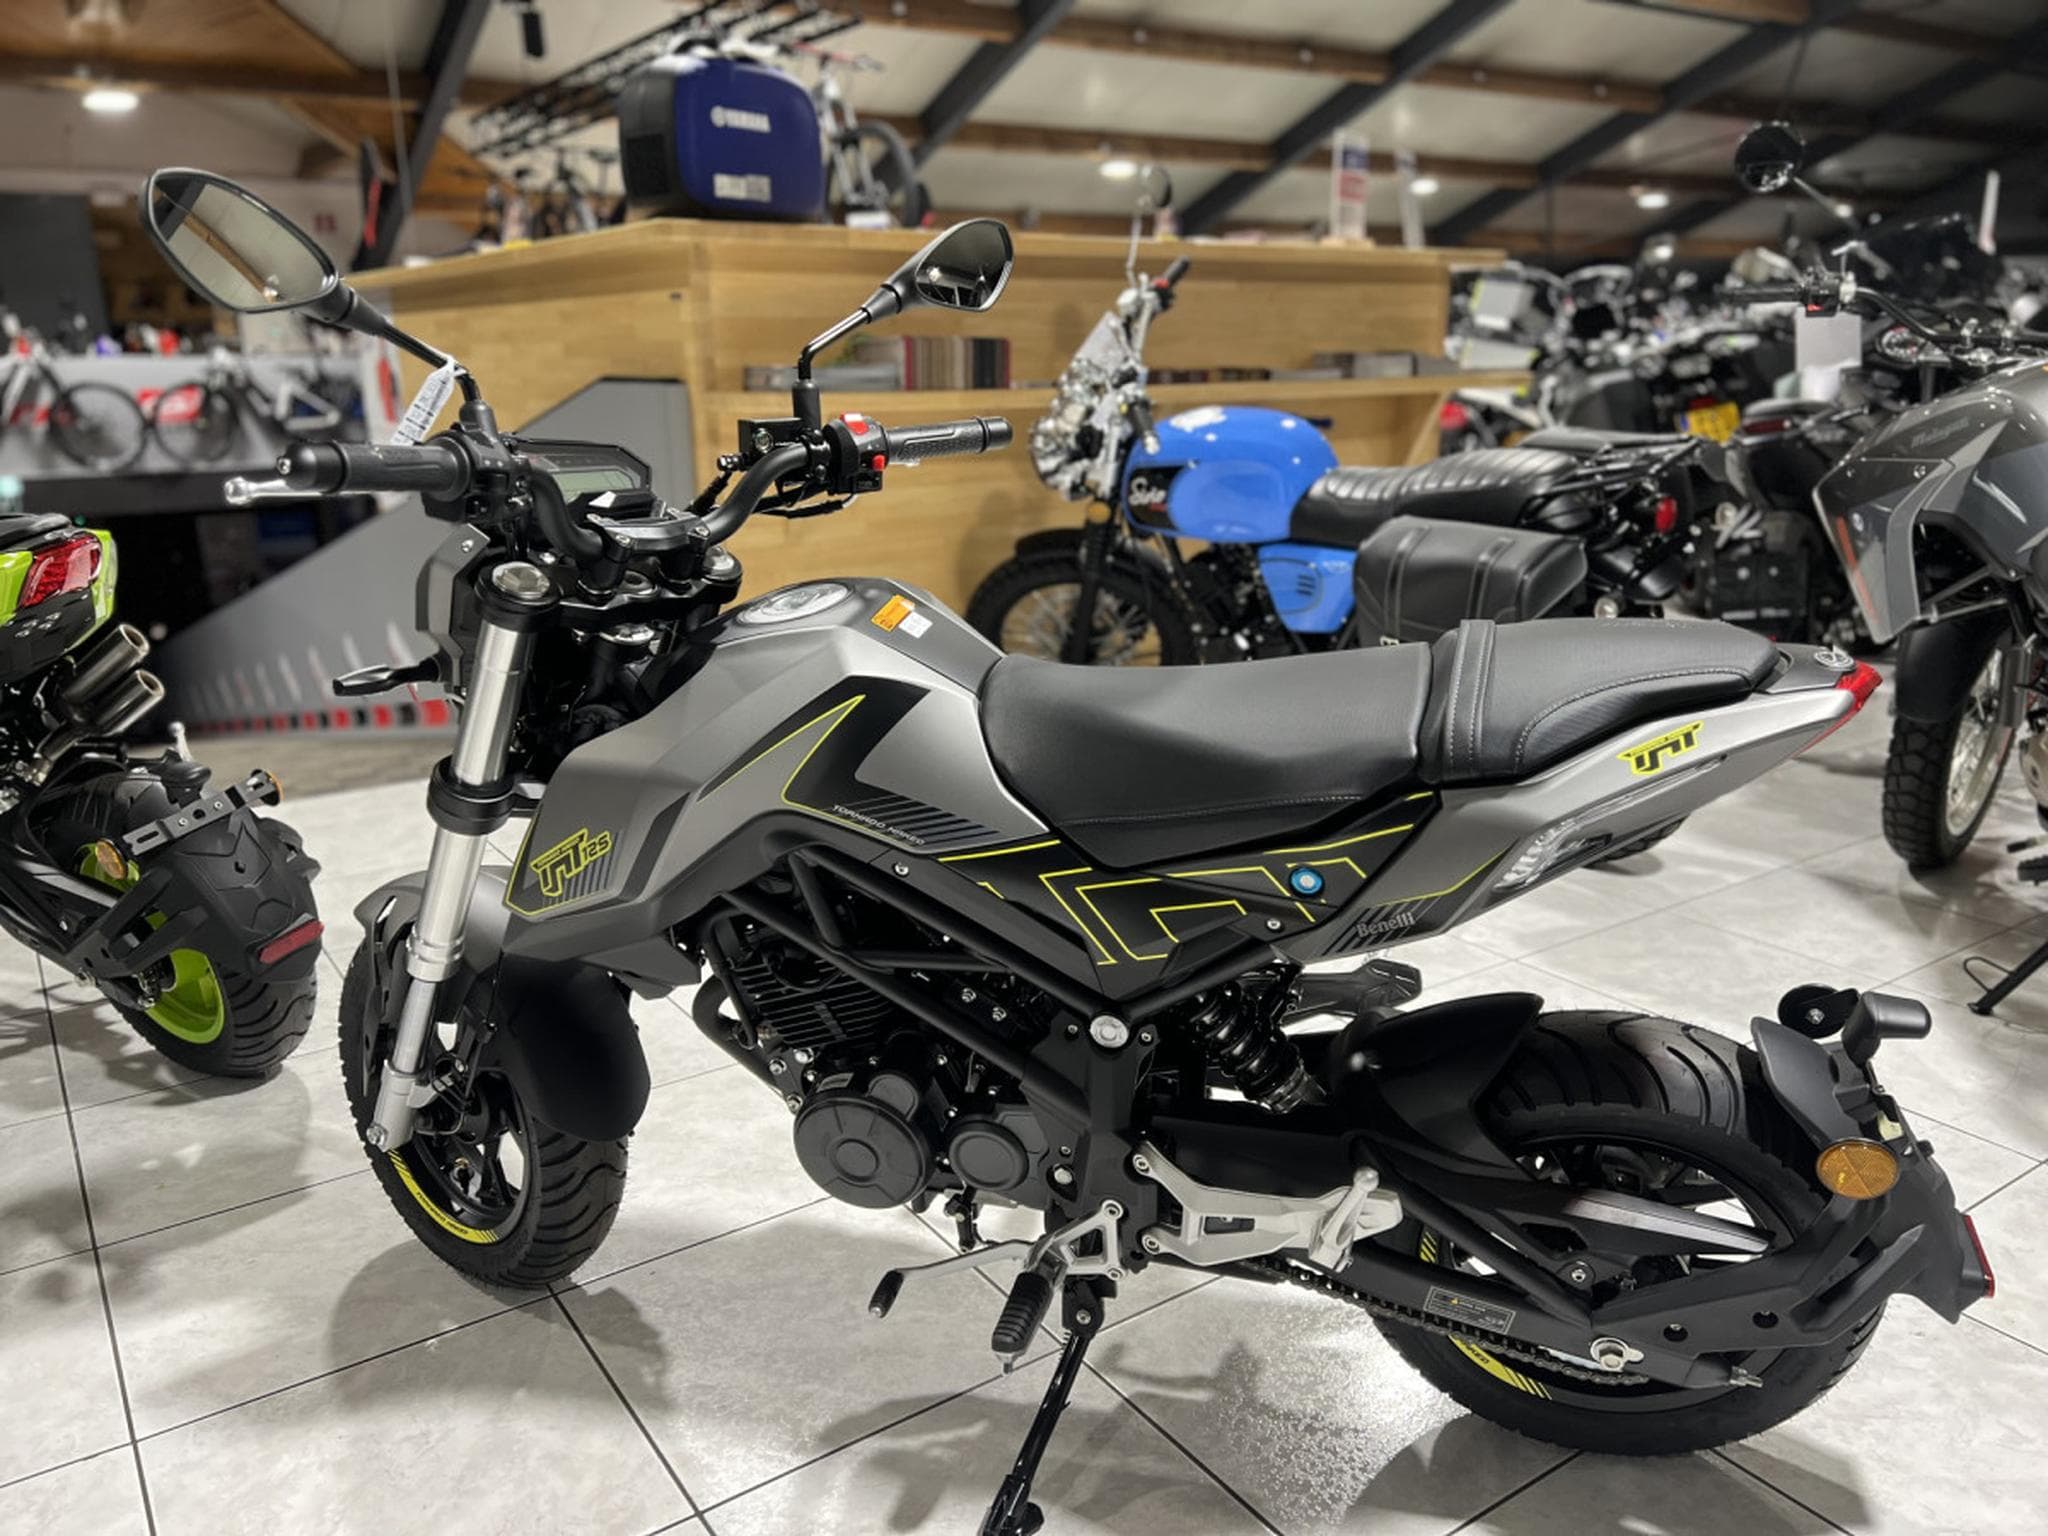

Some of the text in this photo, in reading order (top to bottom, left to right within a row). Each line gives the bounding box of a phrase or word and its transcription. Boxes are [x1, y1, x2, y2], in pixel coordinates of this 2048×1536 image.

[1616, 720, 1704, 775] TNT
[832, 805, 886, 829] TORNADO
[582, 831, 612, 863] 125
[1356, 911, 1416, 938] Benelli
